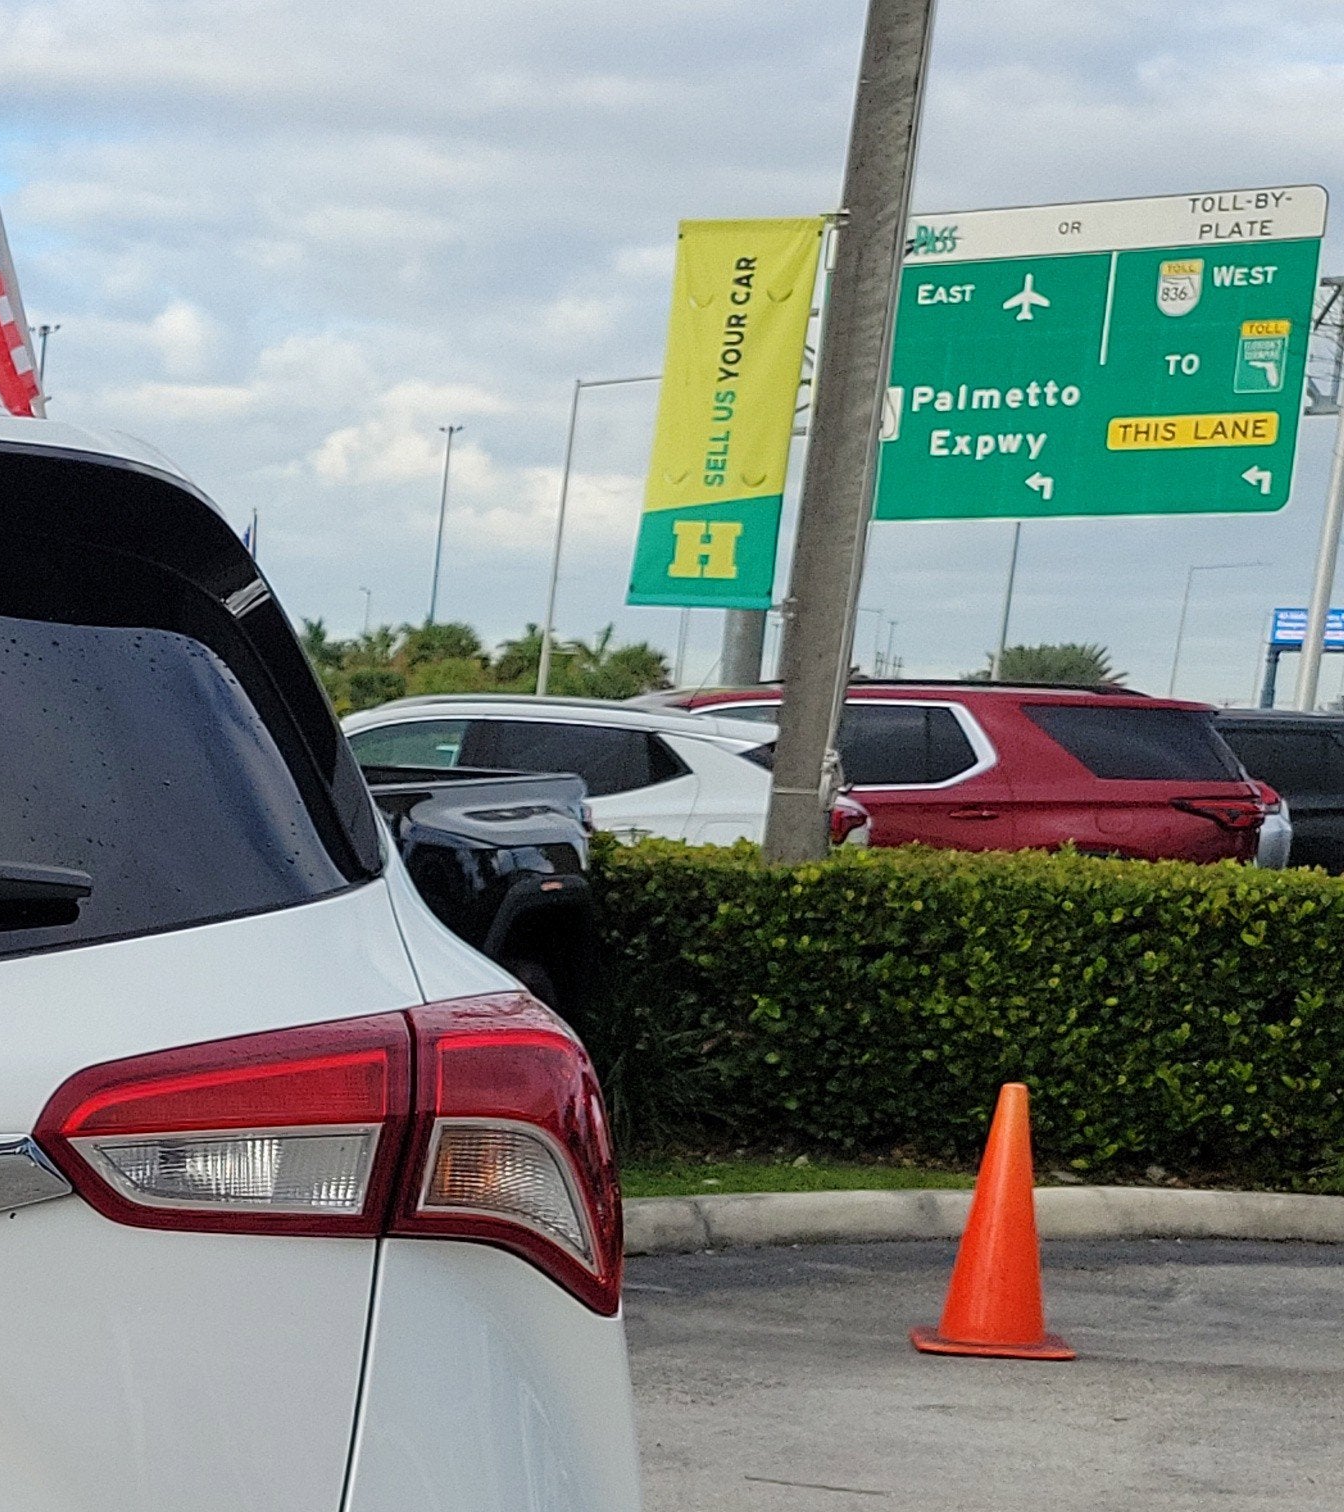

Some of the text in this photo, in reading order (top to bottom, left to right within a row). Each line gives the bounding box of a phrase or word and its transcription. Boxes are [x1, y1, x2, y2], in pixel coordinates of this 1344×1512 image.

[1188, 192, 1293, 213] TOLL-BY-
[1058, 221, 1082, 235] OR
[1199, 220, 1273, 239] PLATE
[1213, 265, 1278, 287] WEST
[917, 284, 975, 304] EAST
[1161, 286, 1188, 301] 836
[1248, 322, 1282, 334] TOLL
[704, 256, 758, 487] SELL US YOUR CAR
[1165, 353, 1200, 375] TO
[912, 380, 1081, 412] Palmetto
[1119, 418, 1268, 442] THIS LANE
[929, 428, 1047, 461] Expwy
